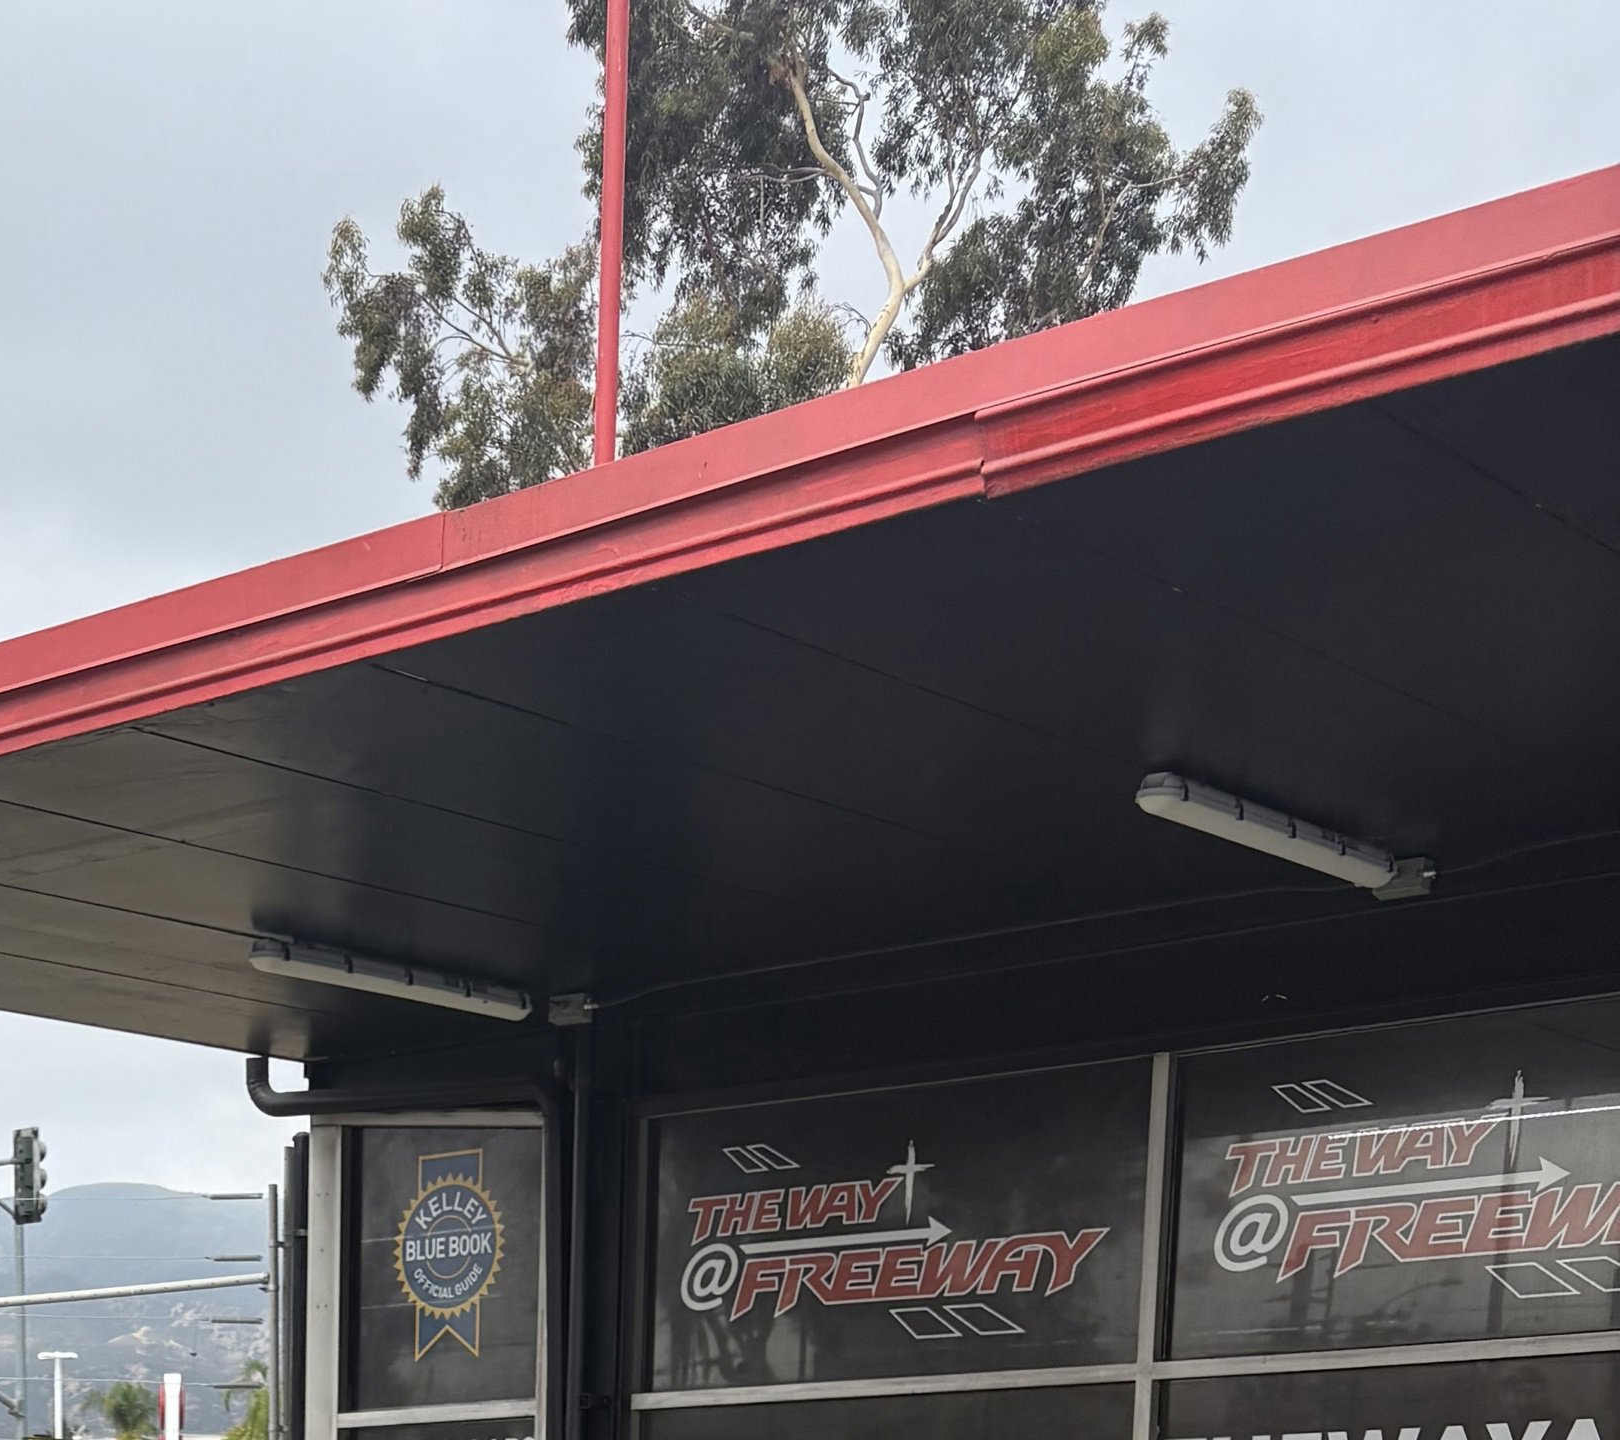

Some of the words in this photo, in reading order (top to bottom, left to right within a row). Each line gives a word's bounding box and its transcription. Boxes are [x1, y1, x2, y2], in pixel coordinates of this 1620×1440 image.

[414, 1191, 487, 1230] KELLEY
[405, 1237, 446, 1263] BLUE
[448, 1231, 493, 1259] BOOK
[1213, 1181, 1620, 1283] @FREEW
[413, 1267, 455, 1299] OFFICIAL
[454, 1262, 484, 1297] GUIDE
